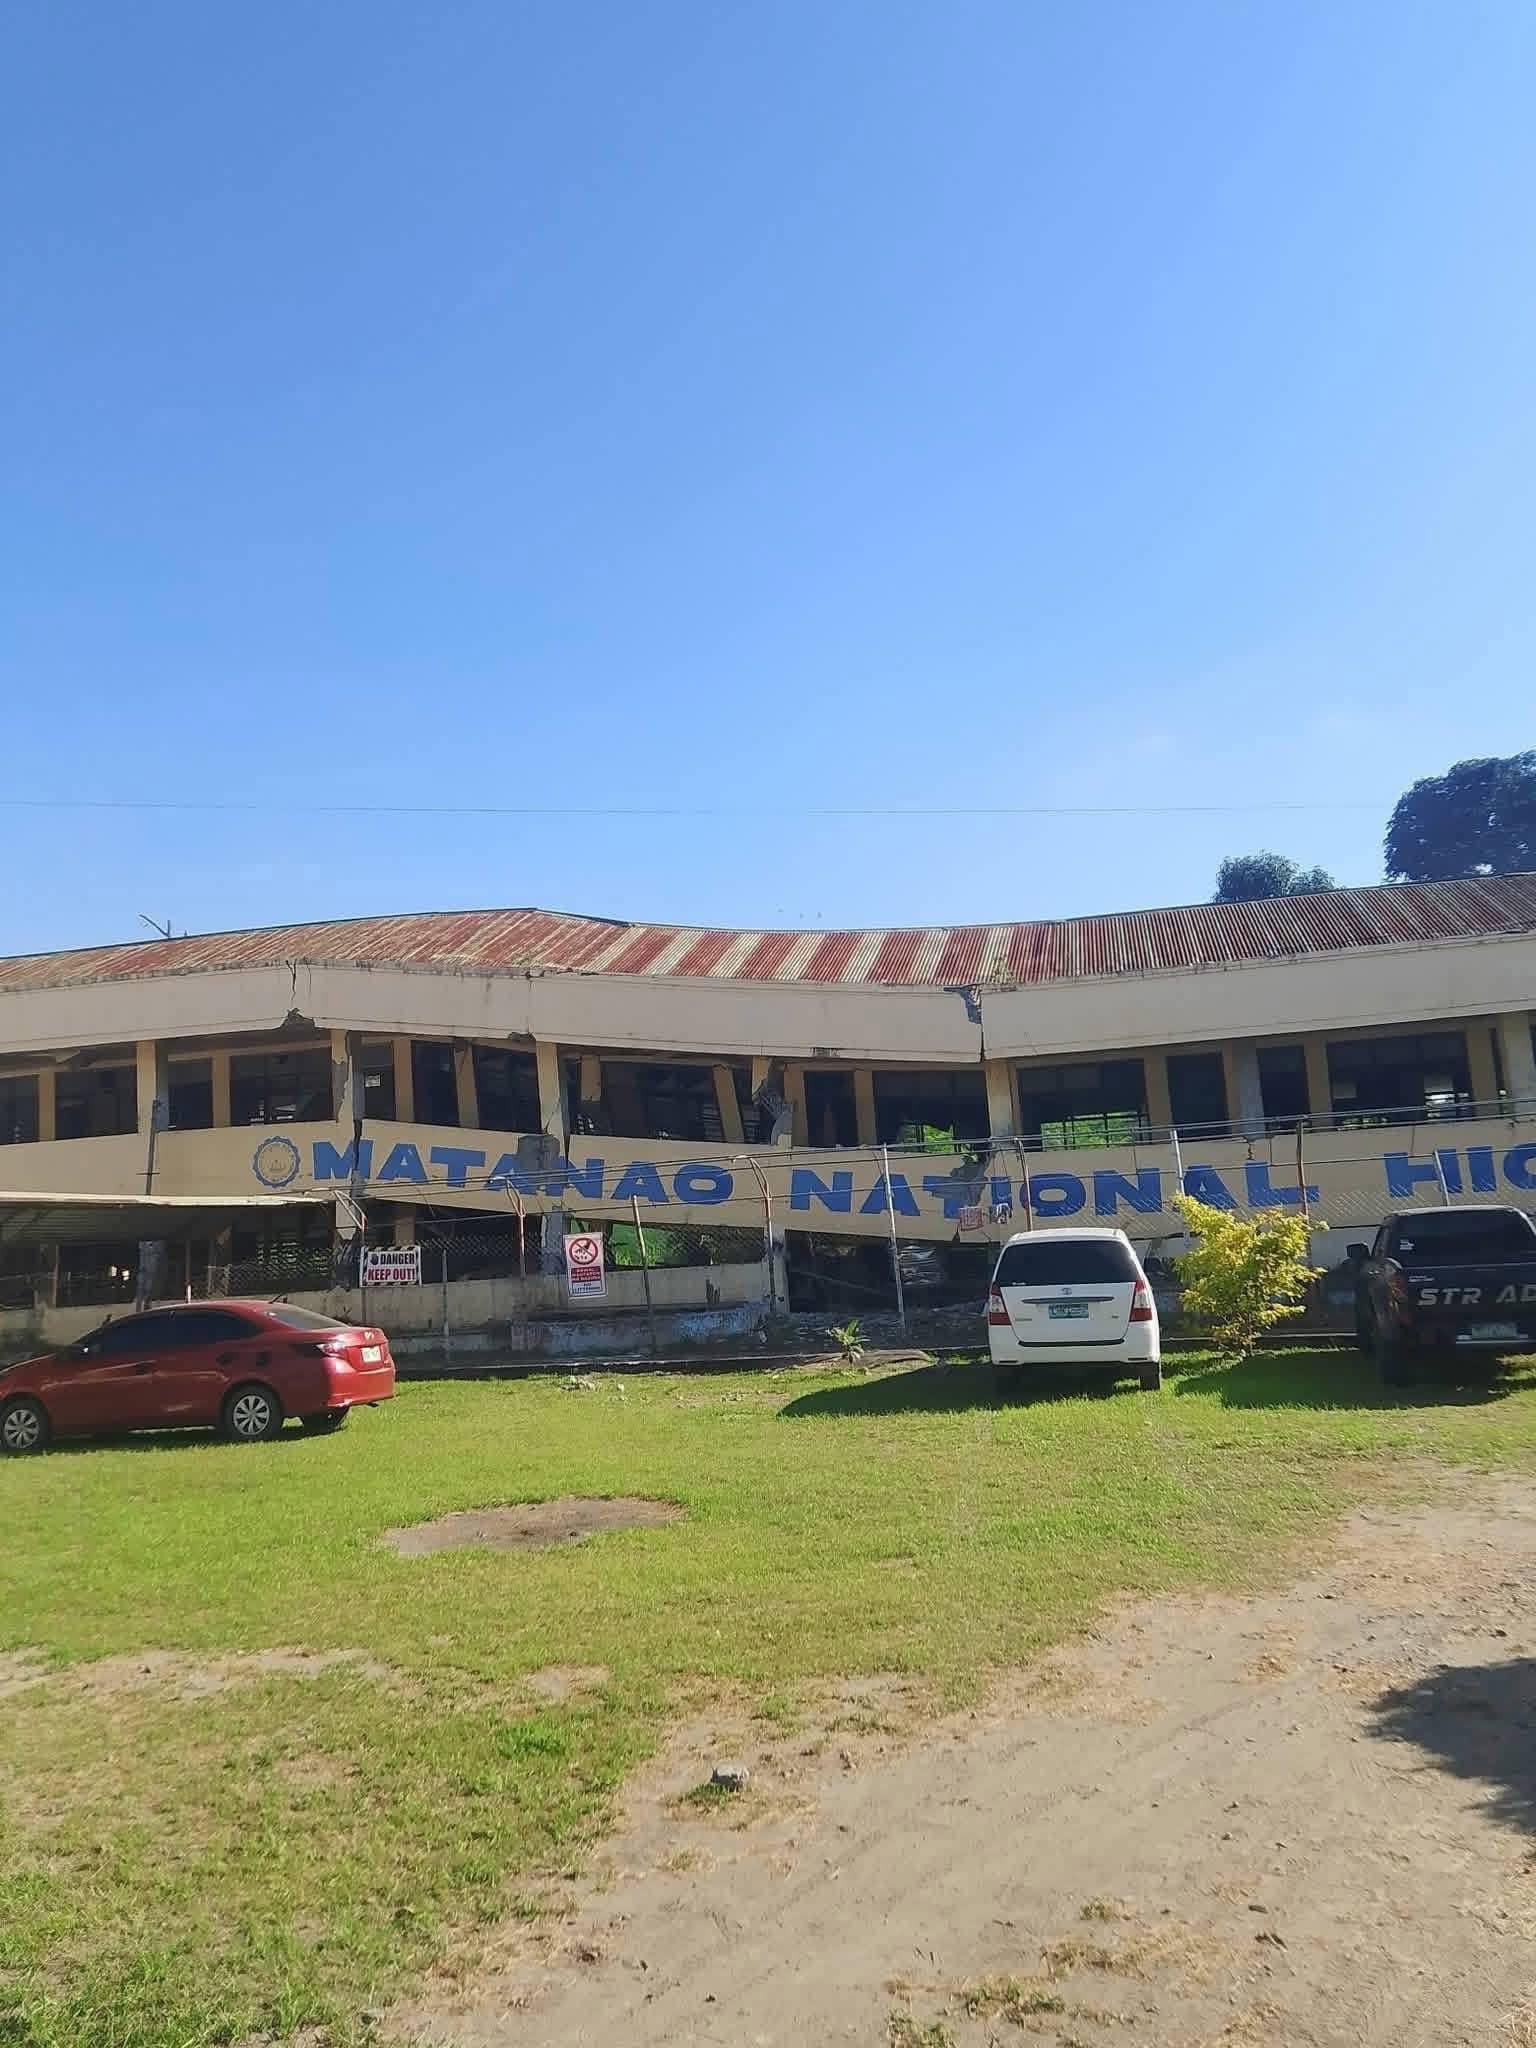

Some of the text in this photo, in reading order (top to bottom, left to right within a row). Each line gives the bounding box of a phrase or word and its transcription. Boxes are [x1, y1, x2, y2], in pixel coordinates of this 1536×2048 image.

[311, 1139, 734, 1205] MATANAO
[790, 1161, 1320, 1219] NATIONAL
[380, 1252, 415, 1265] DANGER
[367, 1267, 416, 1281] KEEP OUT!
[1418, 1287, 1483, 1306] STR
